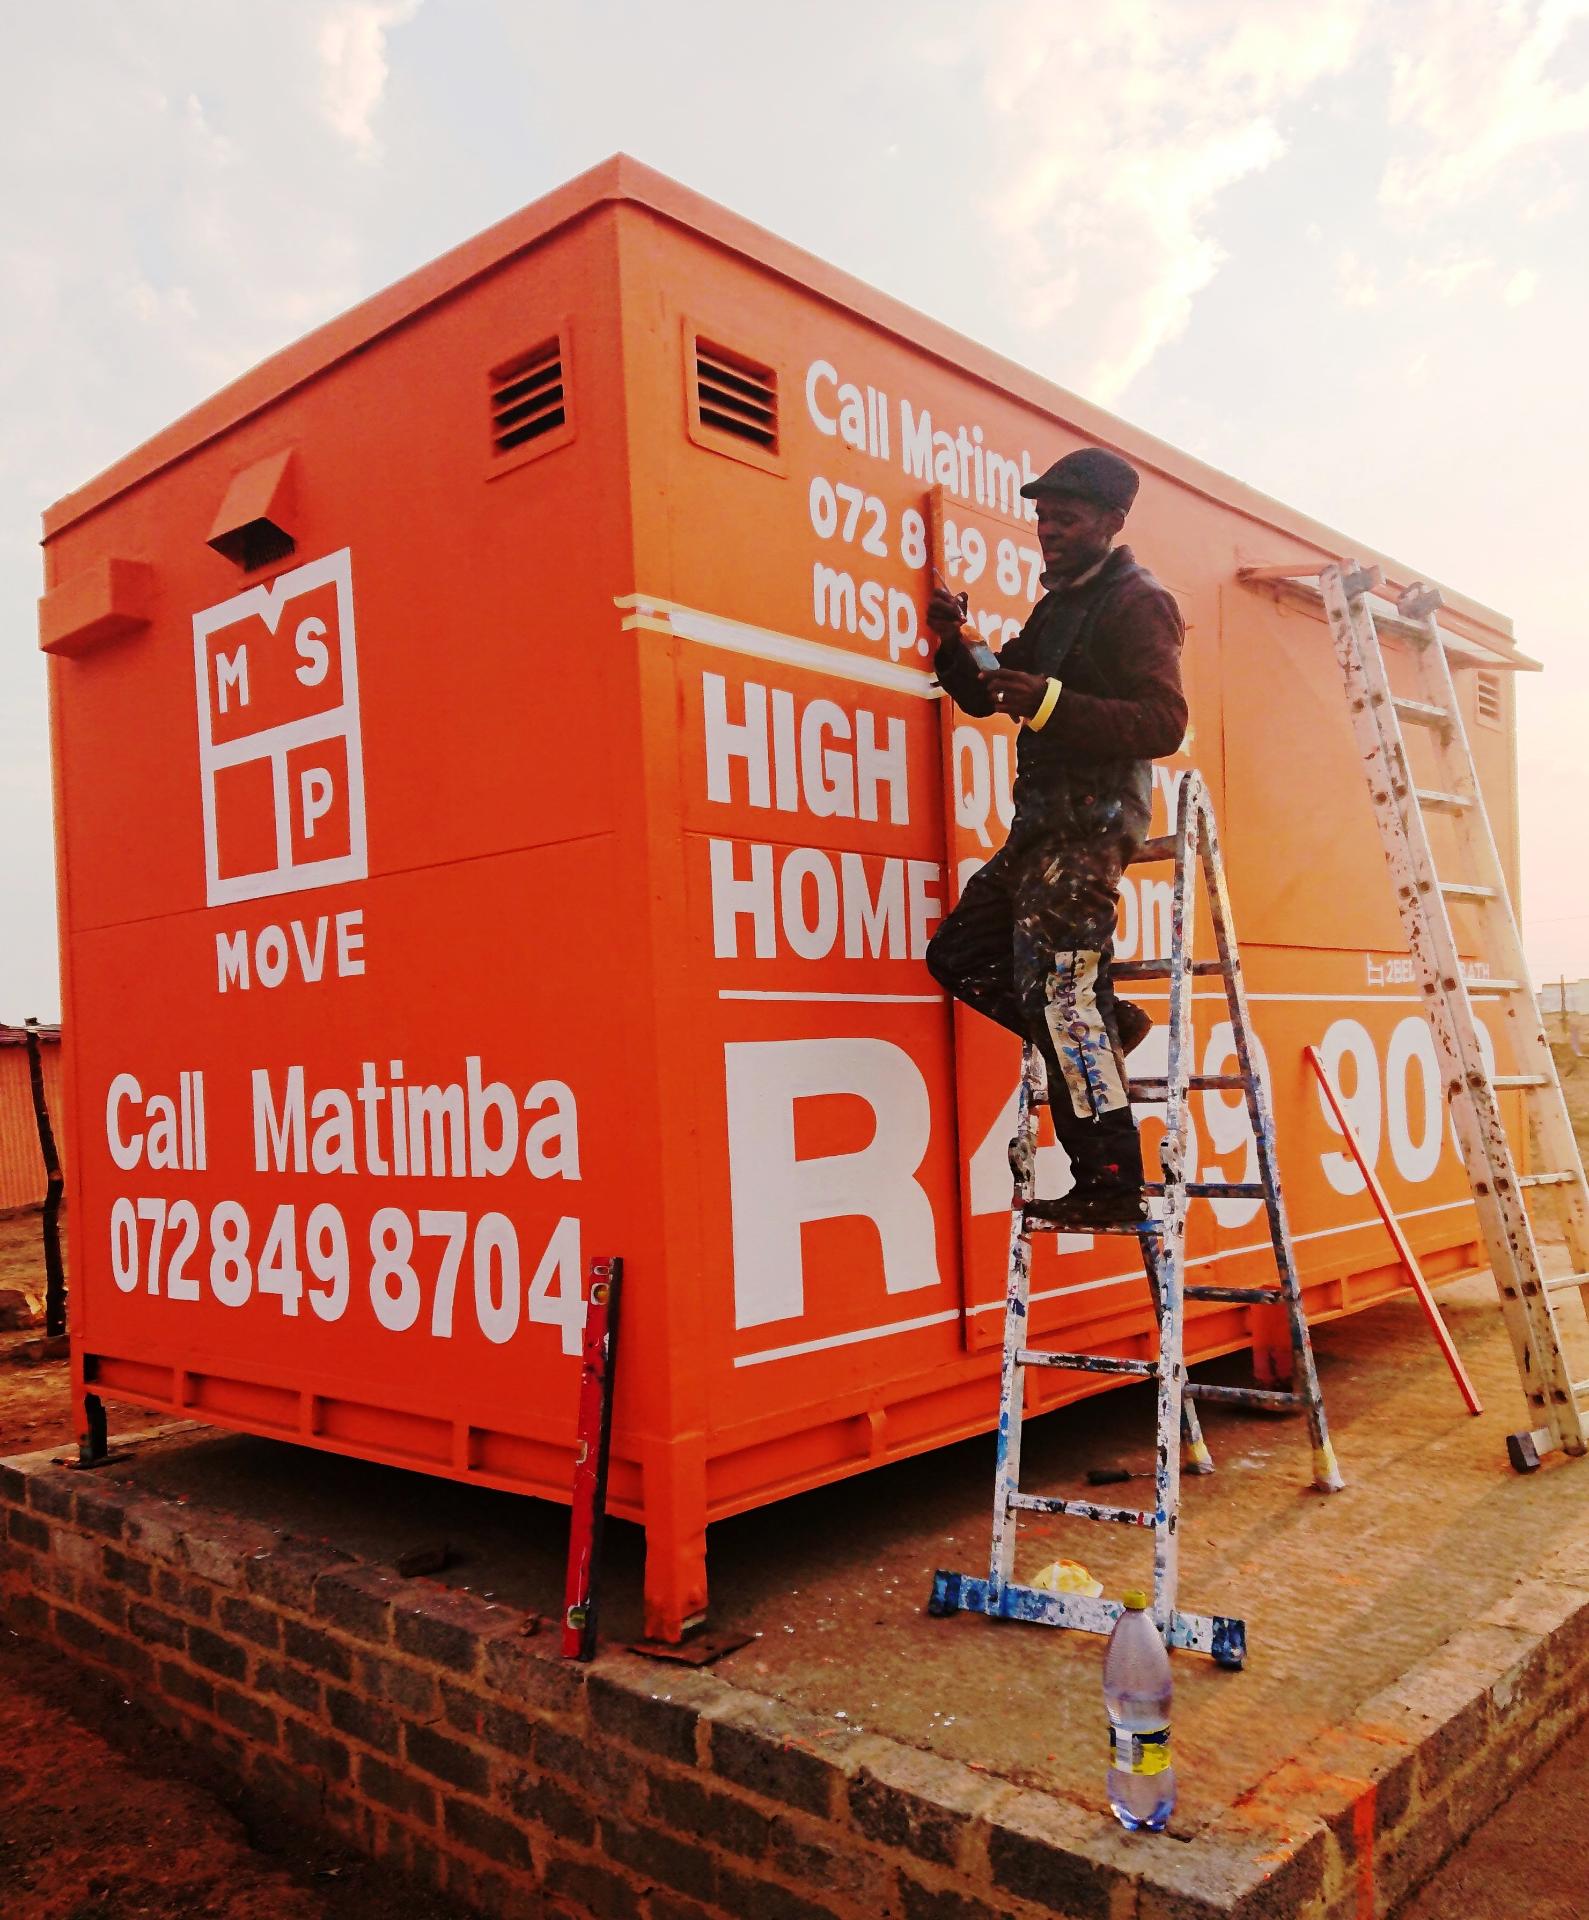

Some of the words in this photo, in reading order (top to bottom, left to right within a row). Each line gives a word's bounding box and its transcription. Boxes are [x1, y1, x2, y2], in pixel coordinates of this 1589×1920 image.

[806, 360, 890, 461] Call
[900, 400, 1040, 521] Matimb
[810, 476, 888, 558] 072
[215, 644, 250, 714] M
[295, 616, 329, 686] S
[301, 767, 334, 839] P
[702, 671, 910, 826] HIGH
[215, 909, 366, 993] MOVE
[106, 1070, 207, 1171] Call
[251, 1055, 582, 1181] Matimba
[369, 1207, 588, 1356] 8704
